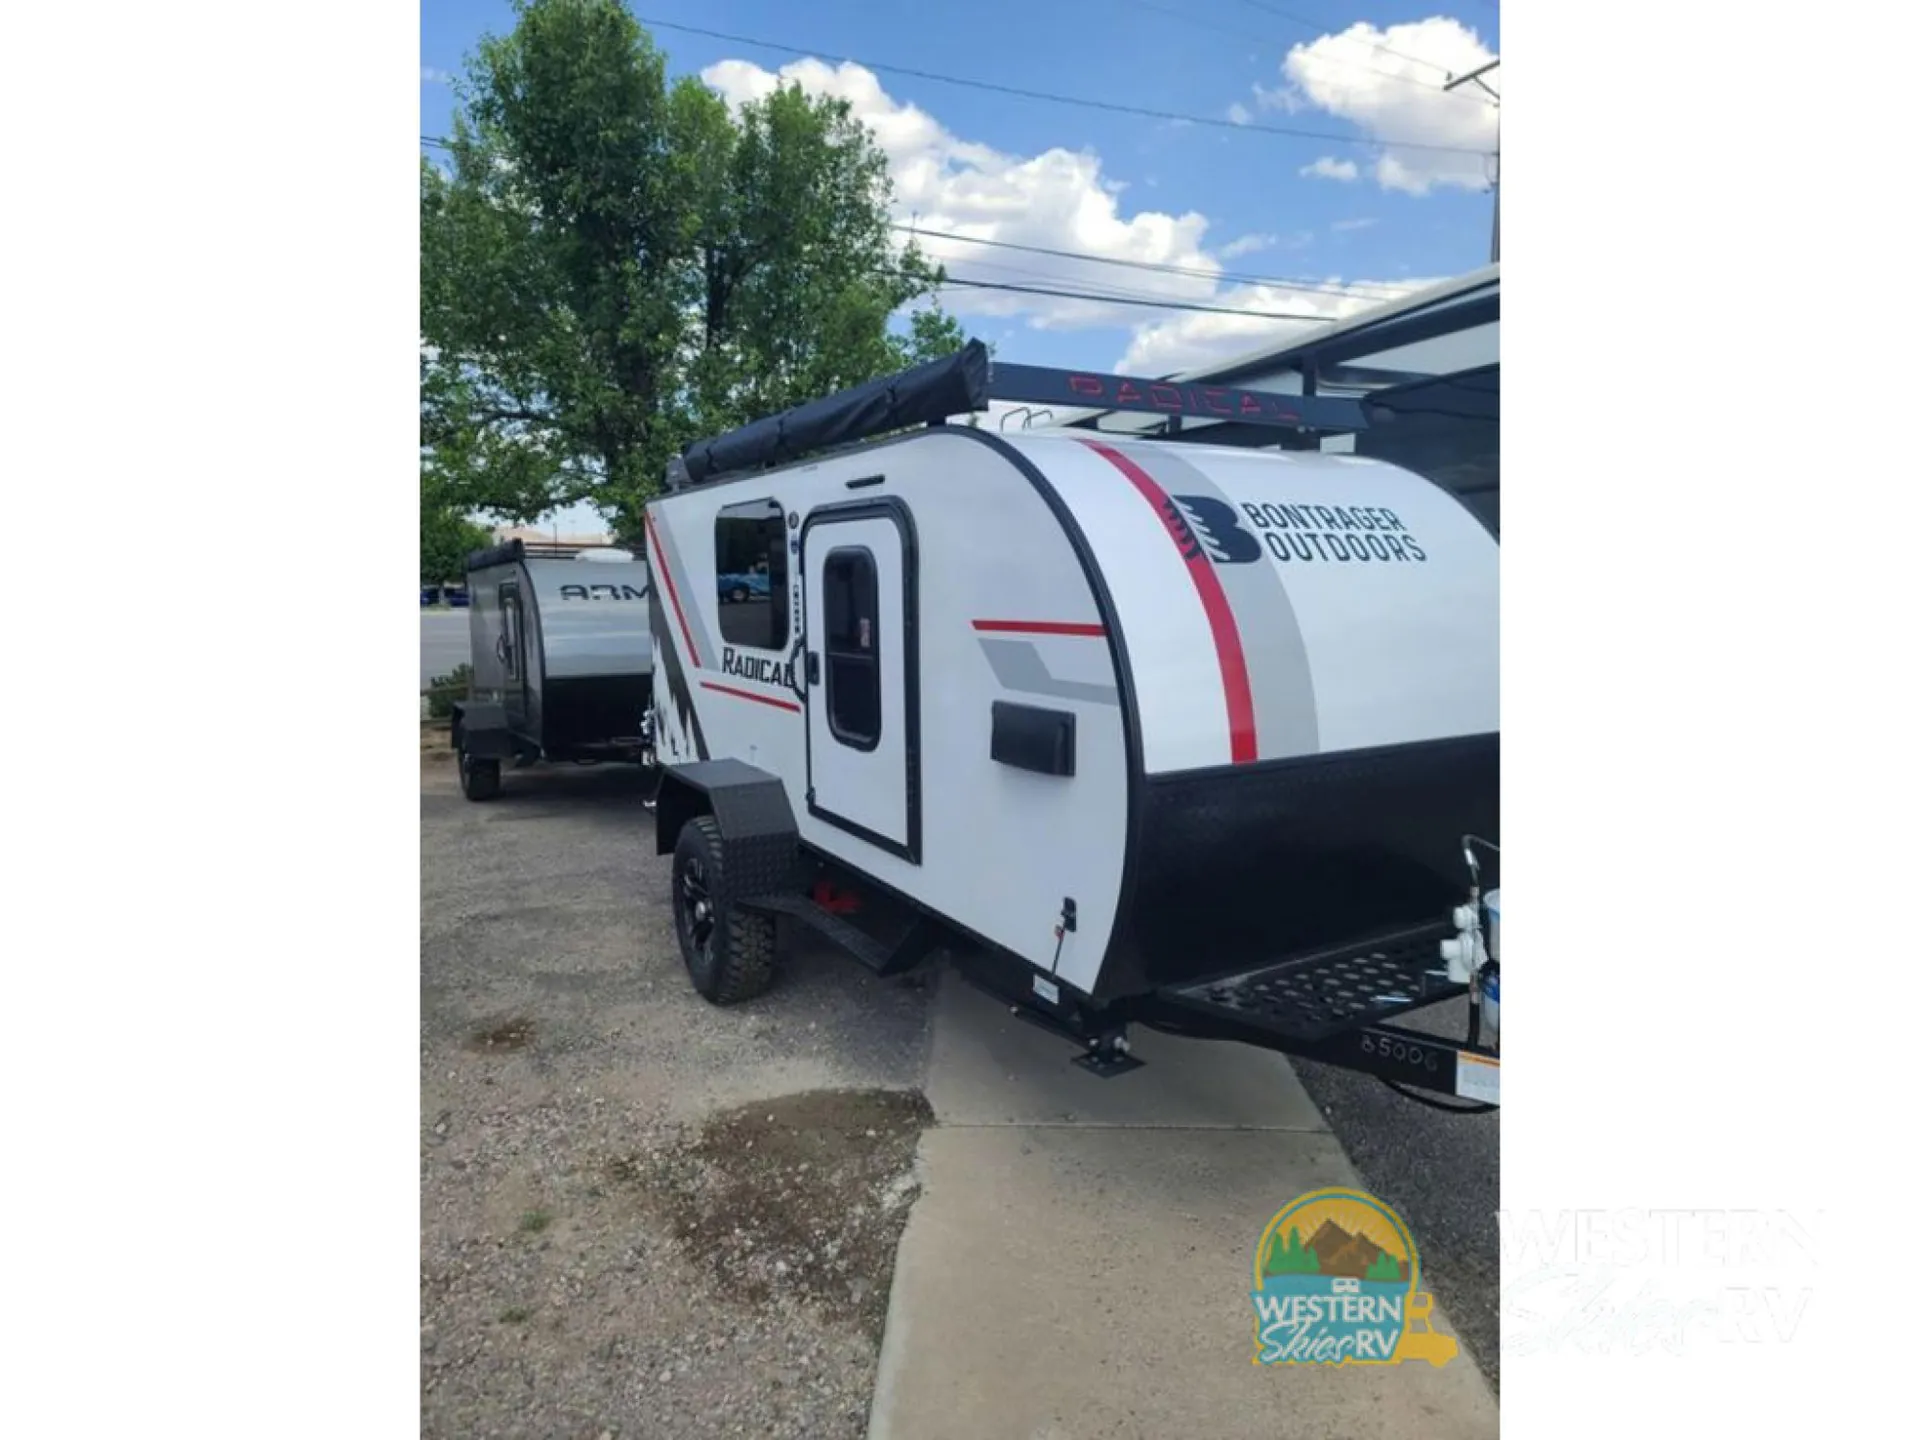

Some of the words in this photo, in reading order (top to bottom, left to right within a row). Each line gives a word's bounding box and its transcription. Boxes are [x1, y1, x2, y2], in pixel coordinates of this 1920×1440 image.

[1068, 375, 1300, 421] RADICAL
[1241, 502, 1408, 532] BONTRAGER
[1263, 532, 1428, 562] OUTDOORS
